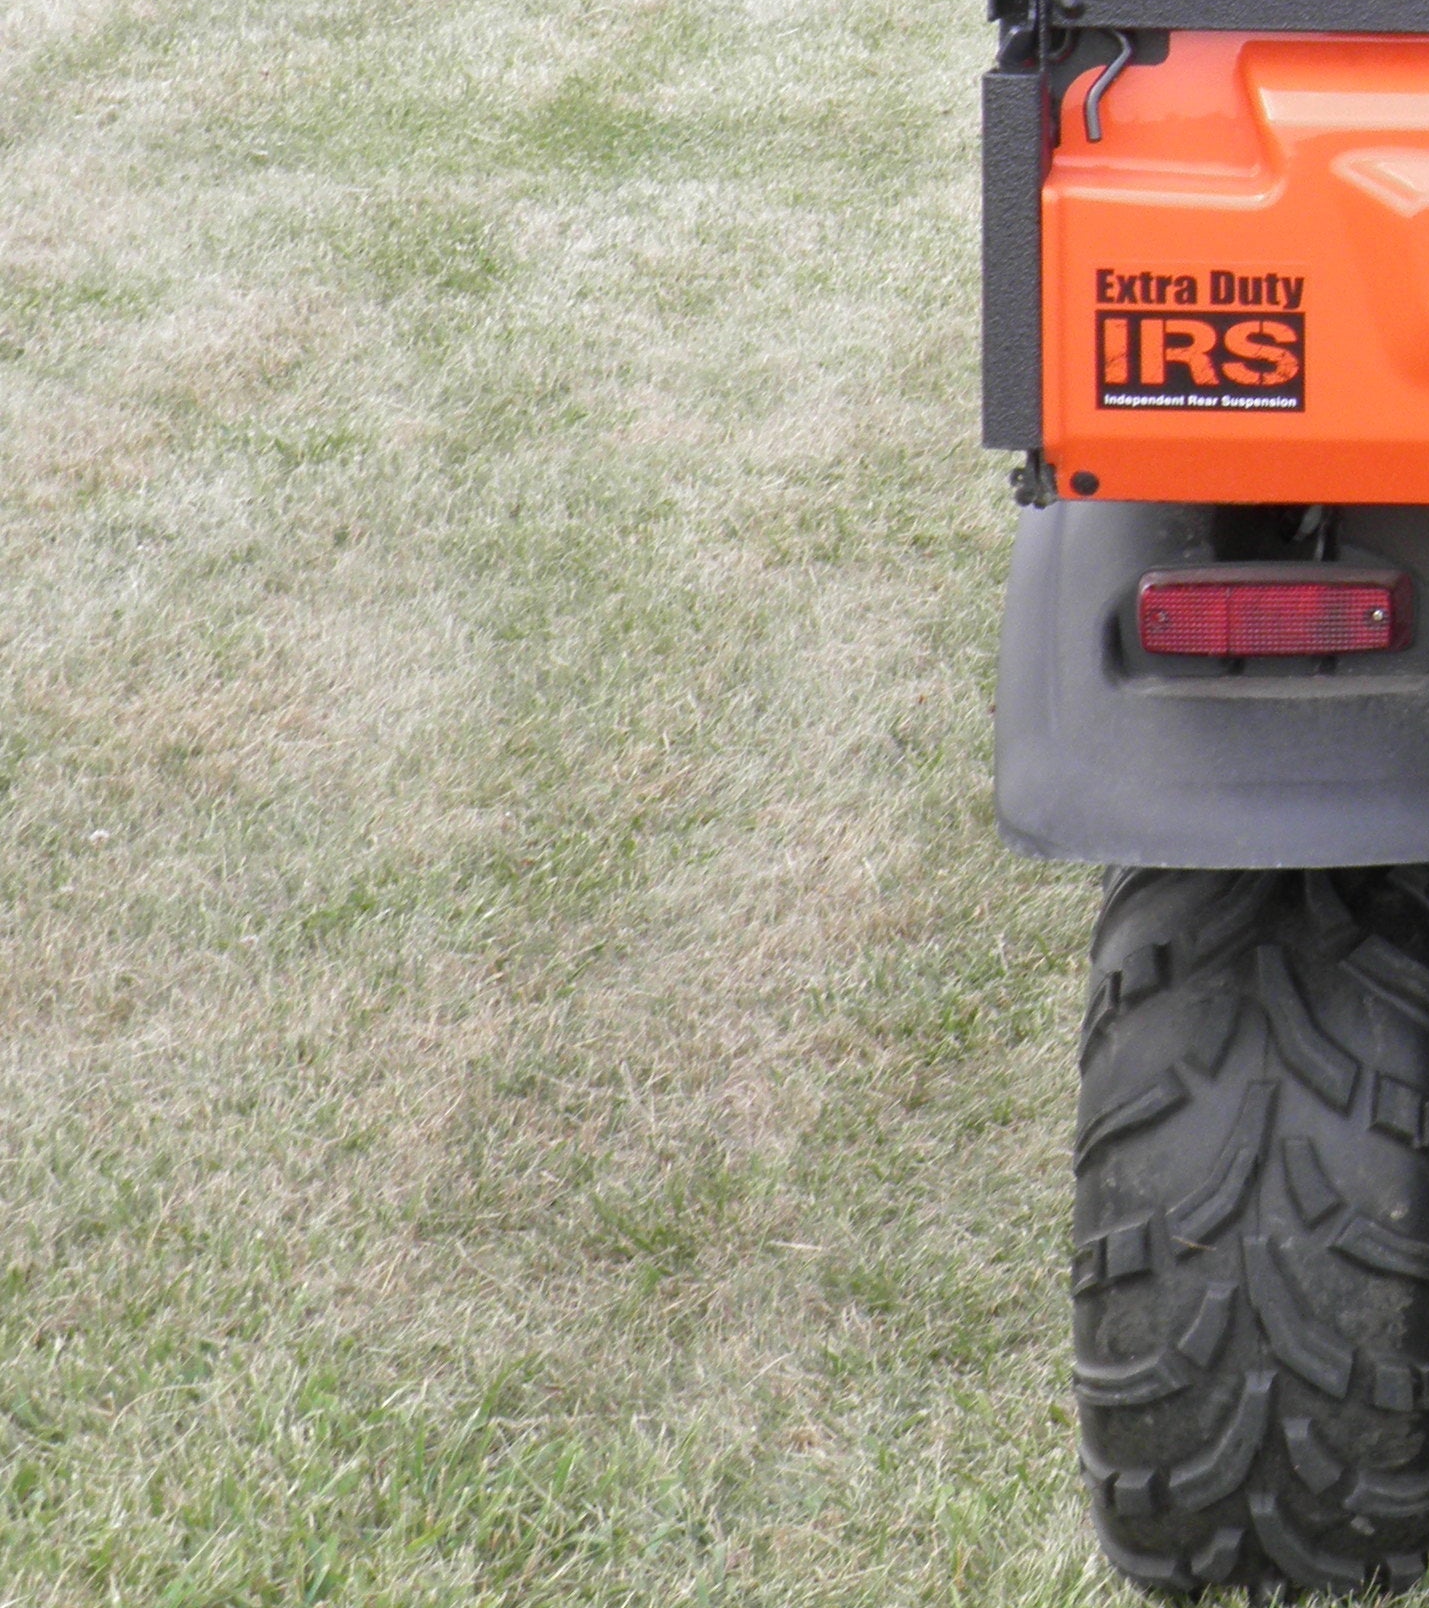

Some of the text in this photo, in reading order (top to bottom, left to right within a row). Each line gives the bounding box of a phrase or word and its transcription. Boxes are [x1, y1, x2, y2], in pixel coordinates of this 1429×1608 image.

[1095, 268, 1305, 310] Extra Duty
[1102, 317, 1300, 388] IRS
[1103, 393, 1297, 410] Independent Rear Suspension
